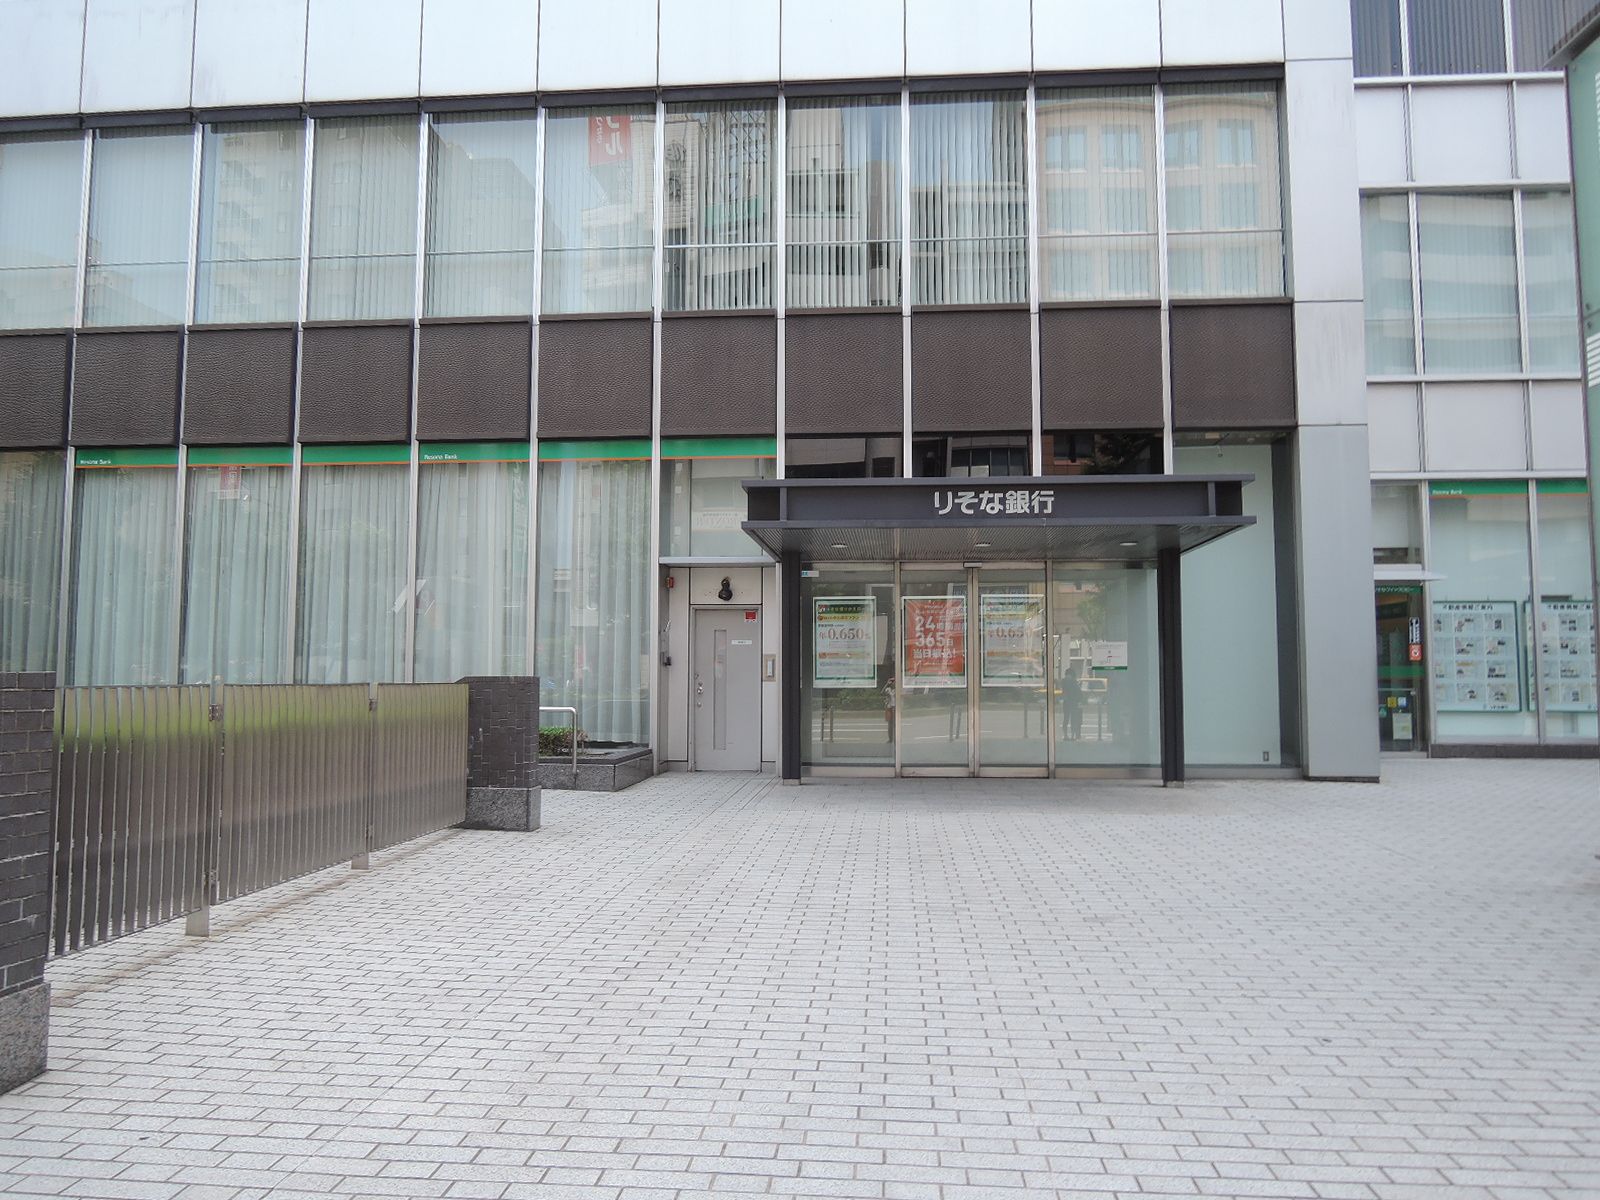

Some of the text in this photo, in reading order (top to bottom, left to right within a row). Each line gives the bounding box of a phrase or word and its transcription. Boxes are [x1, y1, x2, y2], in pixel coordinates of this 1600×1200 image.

[934, 490, 1055, 515] りそな銀行
